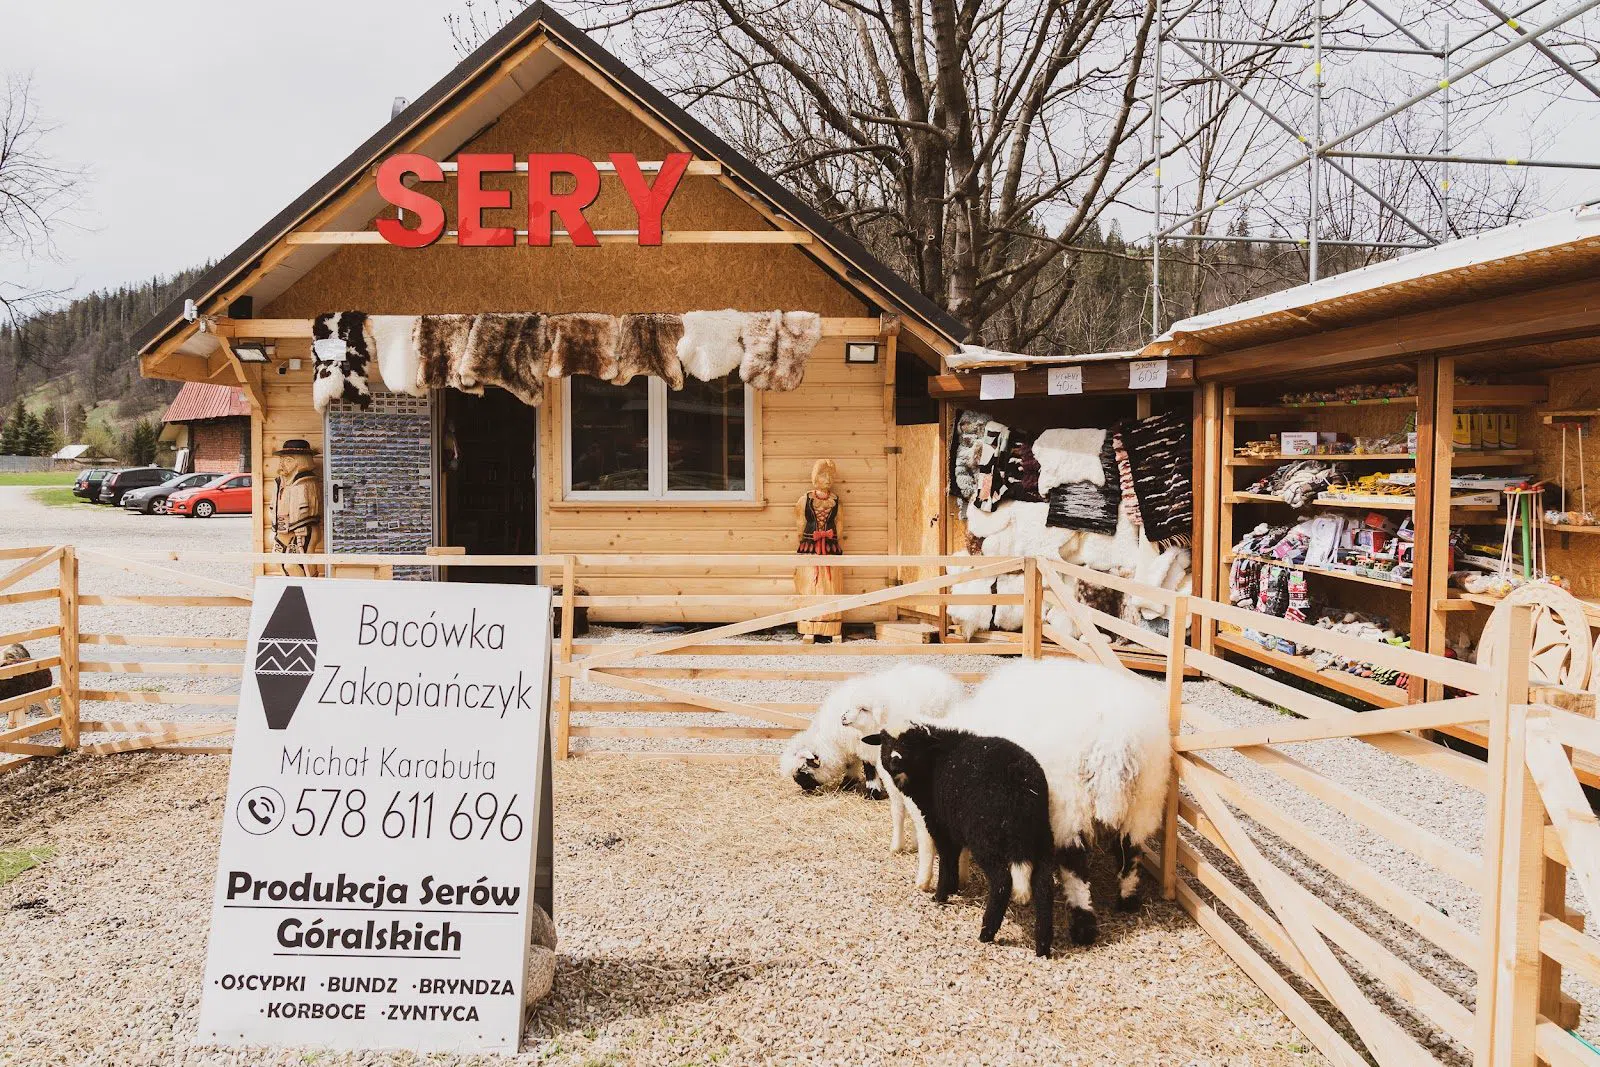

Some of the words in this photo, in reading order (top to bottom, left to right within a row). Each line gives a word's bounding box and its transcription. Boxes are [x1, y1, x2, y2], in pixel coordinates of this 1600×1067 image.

[375, 152, 694, 248] SERY
[358, 604, 505, 650] Bacówka
[317, 664, 532, 719] Zakopiańczyk
[280, 745, 369, 777] Michał
[380, 747, 496, 780] Karabuła
[291, 788, 367, 838] 578
[381, 790, 435, 839] 611
[449, 792, 523, 842] 696
[226, 870, 409, 904] Produkcja
[418, 874, 521, 907] Serów
[276, 917, 462, 952] Góralskich
